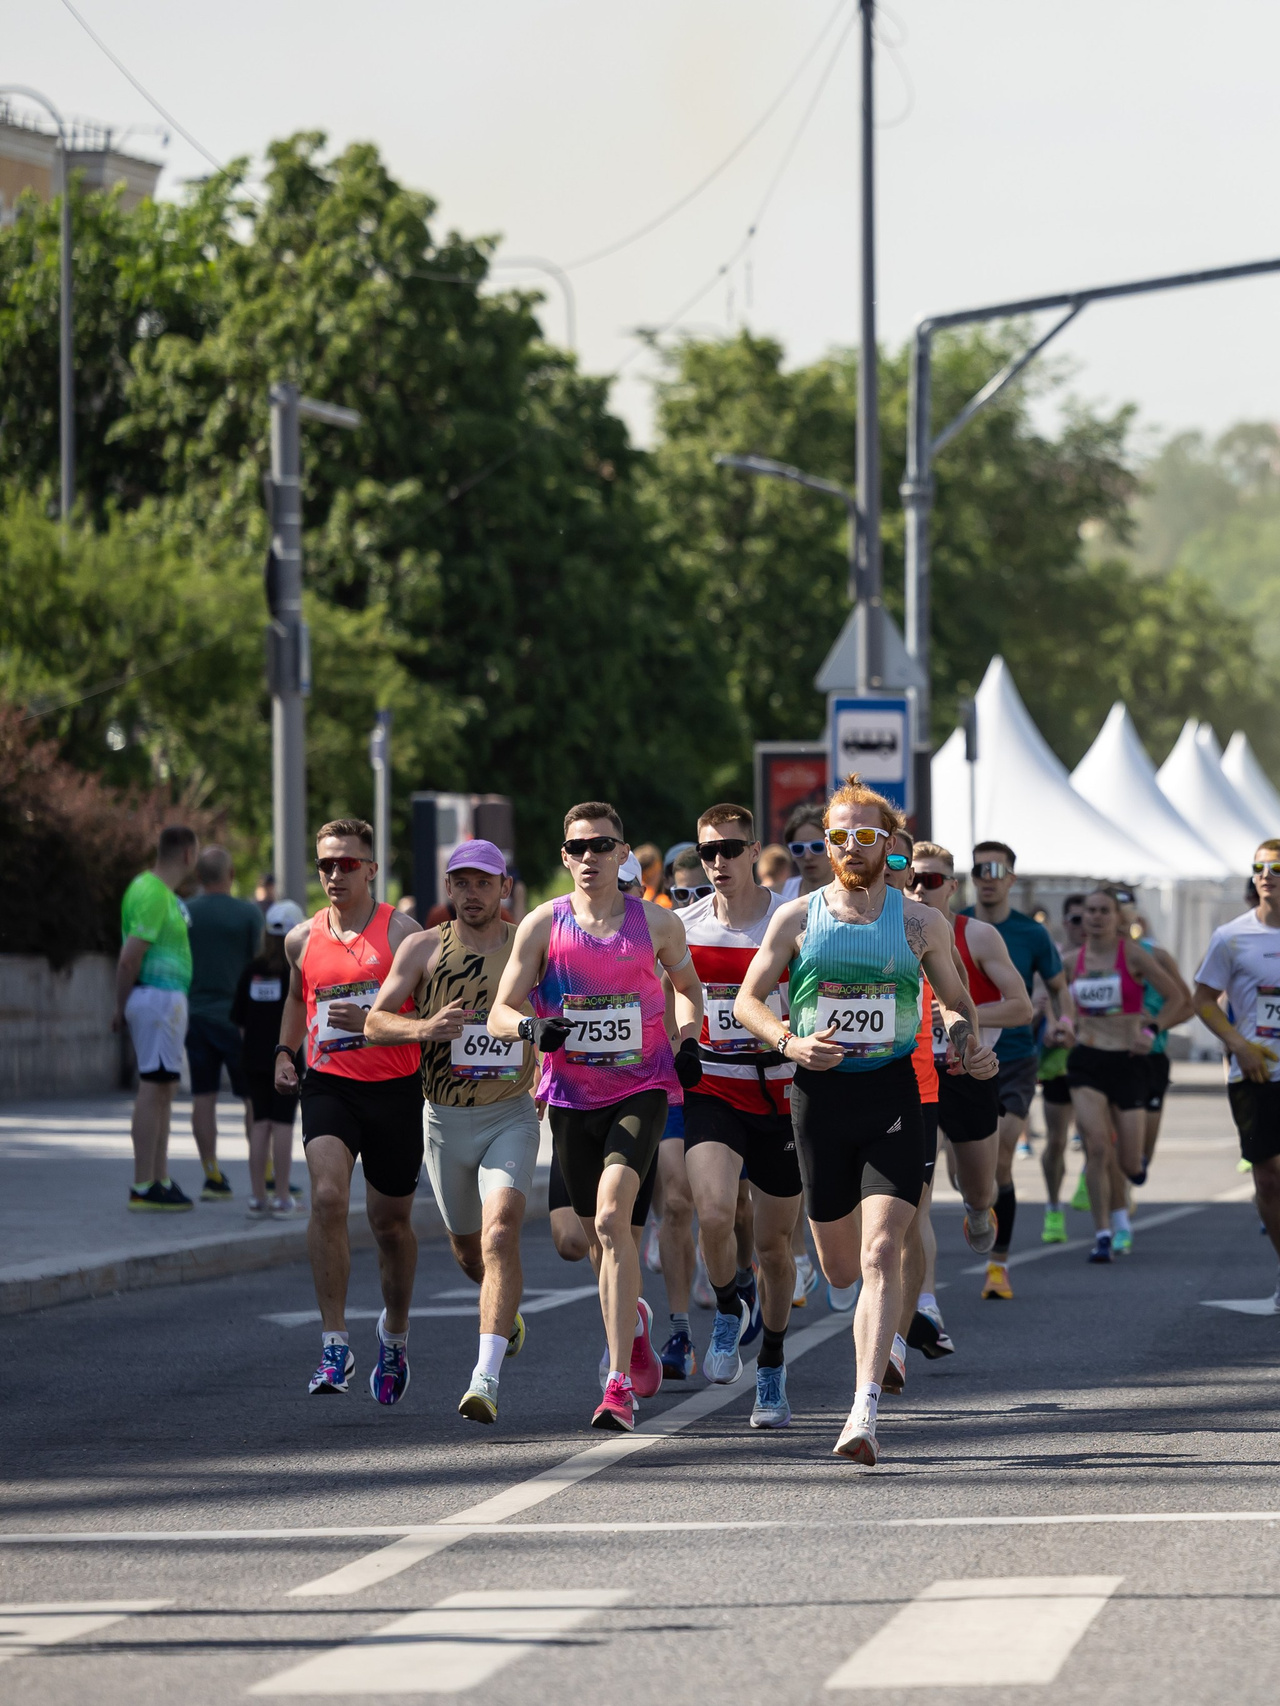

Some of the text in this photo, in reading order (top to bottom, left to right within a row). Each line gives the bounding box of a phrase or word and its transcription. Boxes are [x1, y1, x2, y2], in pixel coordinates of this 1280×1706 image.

[575, 1019, 631, 1042] 7535
[827, 1010, 884, 1032] 6290
[464, 1035, 513, 1056] 6949
